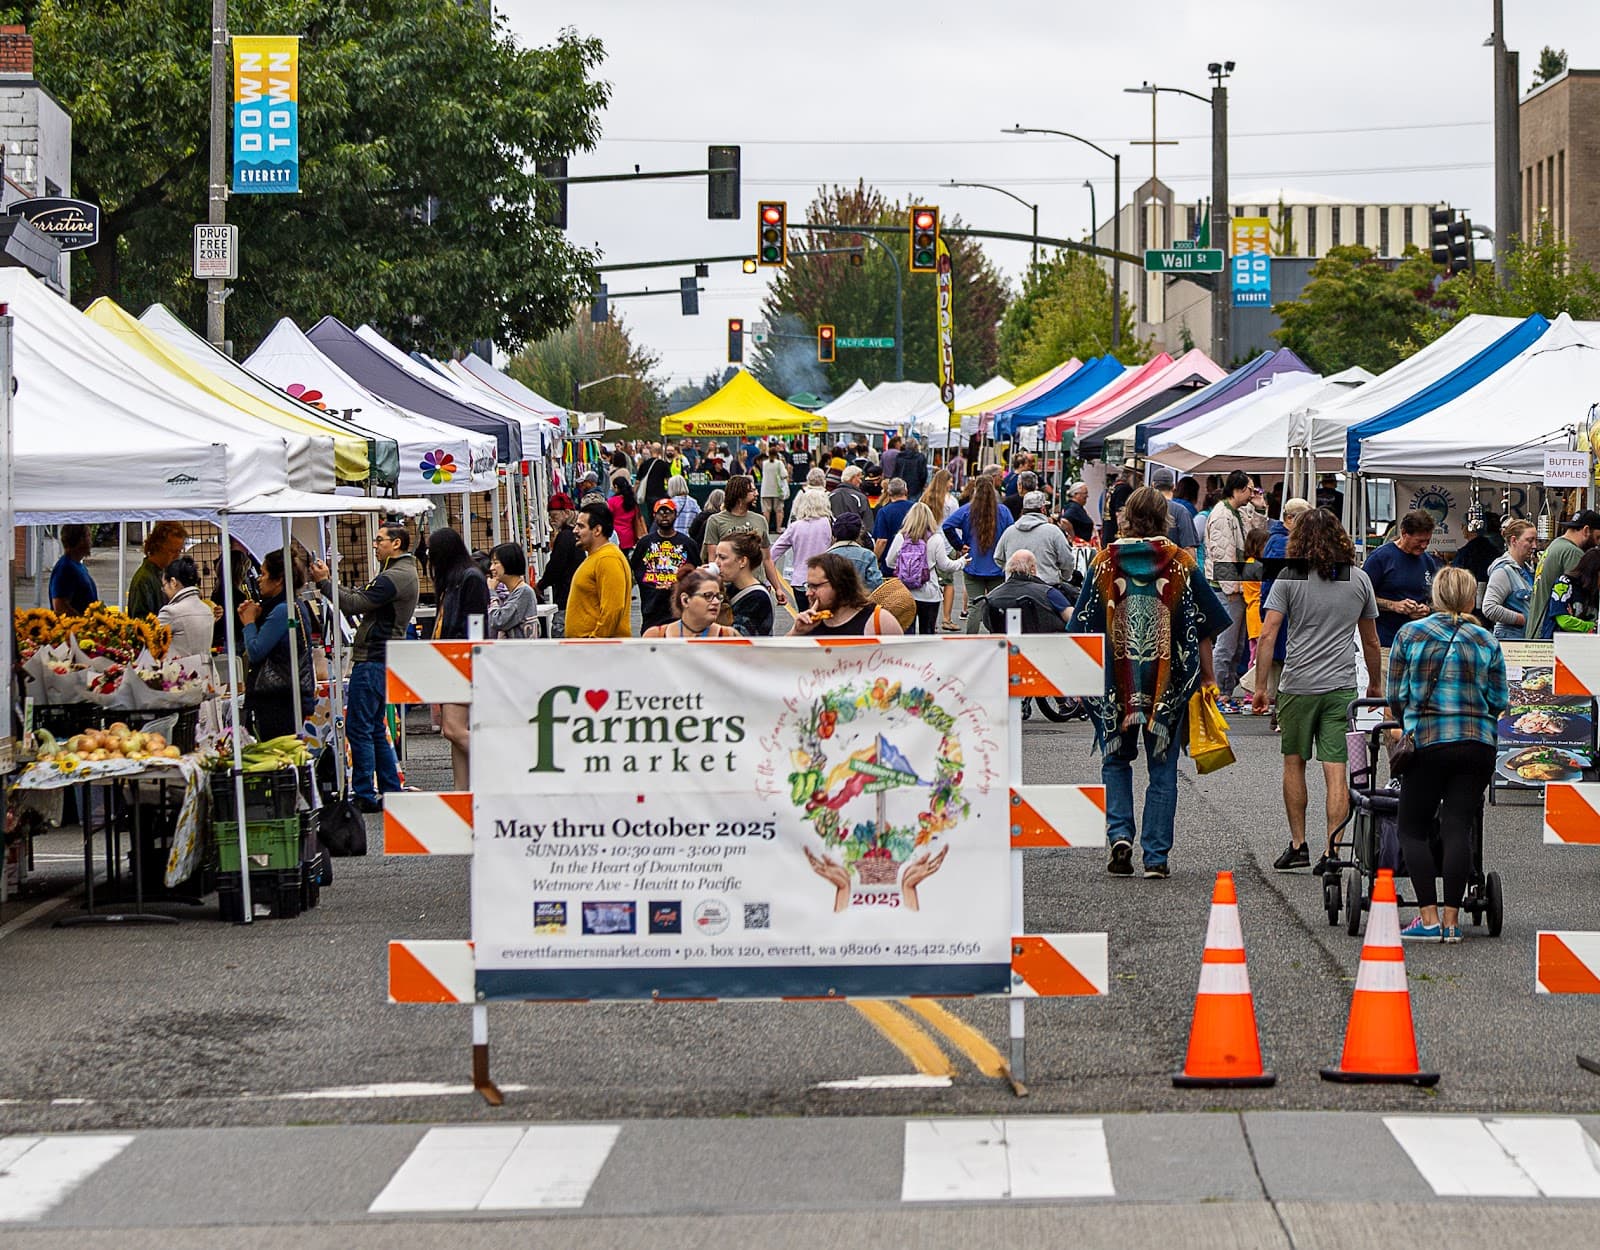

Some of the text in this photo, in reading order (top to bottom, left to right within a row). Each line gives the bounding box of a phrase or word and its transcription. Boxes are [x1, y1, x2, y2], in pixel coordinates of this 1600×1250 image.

[240, 53, 262, 152] DOWN
[269, 52, 291, 151] TOWN
[241, 169, 291, 182] EVERETT
[200, 228, 227, 238] DRUG
[200, 239, 227, 249] FREE
[200, 250, 227, 258] ZONE
[1162, 253, 1206, 268] Wall St
[1237, 226, 1249, 284] DOWN
[1253, 226, 1265, 283] TOWN
[837, 339, 882, 347] PACIFIC AVE
[1549, 458, 1584, 466] BUTTER
[1546, 470, 1586, 478] SAMPLES
[616, 690, 704, 710] Everett
[529, 686, 745, 772] farmers
[584, 748, 737, 772] market
[495, 818, 776, 841] May thru October 2025
[526, 844, 599, 857] SUNDAYS
[611, 845, 649, 858] 10:30
[653, 847, 676, 856] am
[687, 846, 720, 858] 3:00
[723, 847, 746, 858] pm
[550, 861, 722, 876] In the Heart of Downtown
[533, 879, 593, 891] Wetmore
[596, 879, 621, 890] Ave
[633, 879, 678, 890] Hewitt
[681, 880, 695, 890] to
[697, 877, 742, 890] Pacific
[853, 893, 900, 907] 2025
[502, 946, 671, 960] everettfarmersmarket.com
[684, 947, 708, 960] p.o.
[711, 945, 734, 957] box
[768, 945, 815, 957] everett,
[819, 946, 836, 955] wa
[840, 943, 881, 957] 98206
[894, 941, 981, 956] 425.422.5656
